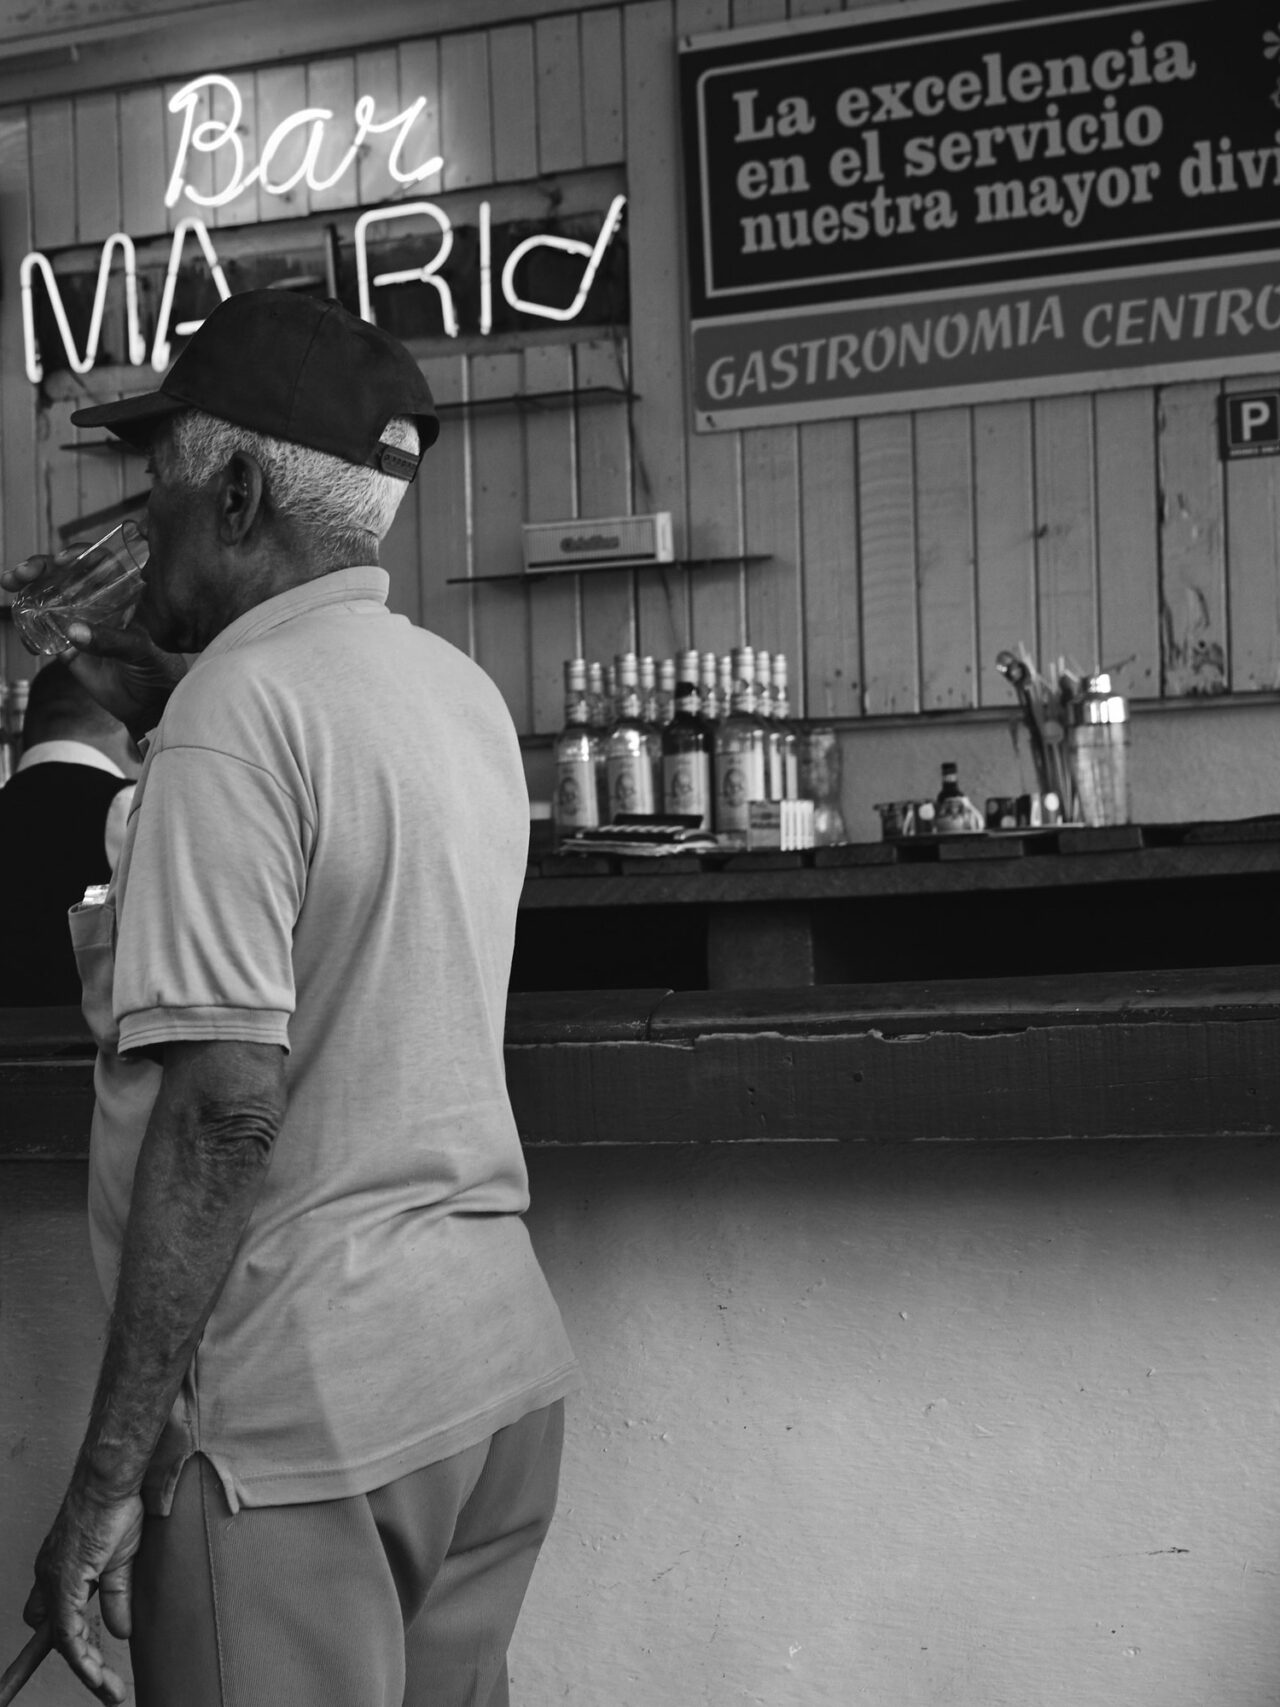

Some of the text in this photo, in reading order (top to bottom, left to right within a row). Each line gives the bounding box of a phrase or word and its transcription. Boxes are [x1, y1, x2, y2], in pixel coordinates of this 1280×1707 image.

[733, 31, 1196, 142] La excelencia
[165, 75, 443, 208] Bar
[736, 95, 1164, 199] en el servicio
[740, 187, 958, 254] nuestra
[975, 160, 1161, 228] mayor
[706, 284, 1280, 401] GASTRONOMIA CENTRO
[1241, 401, 1270, 442] P
